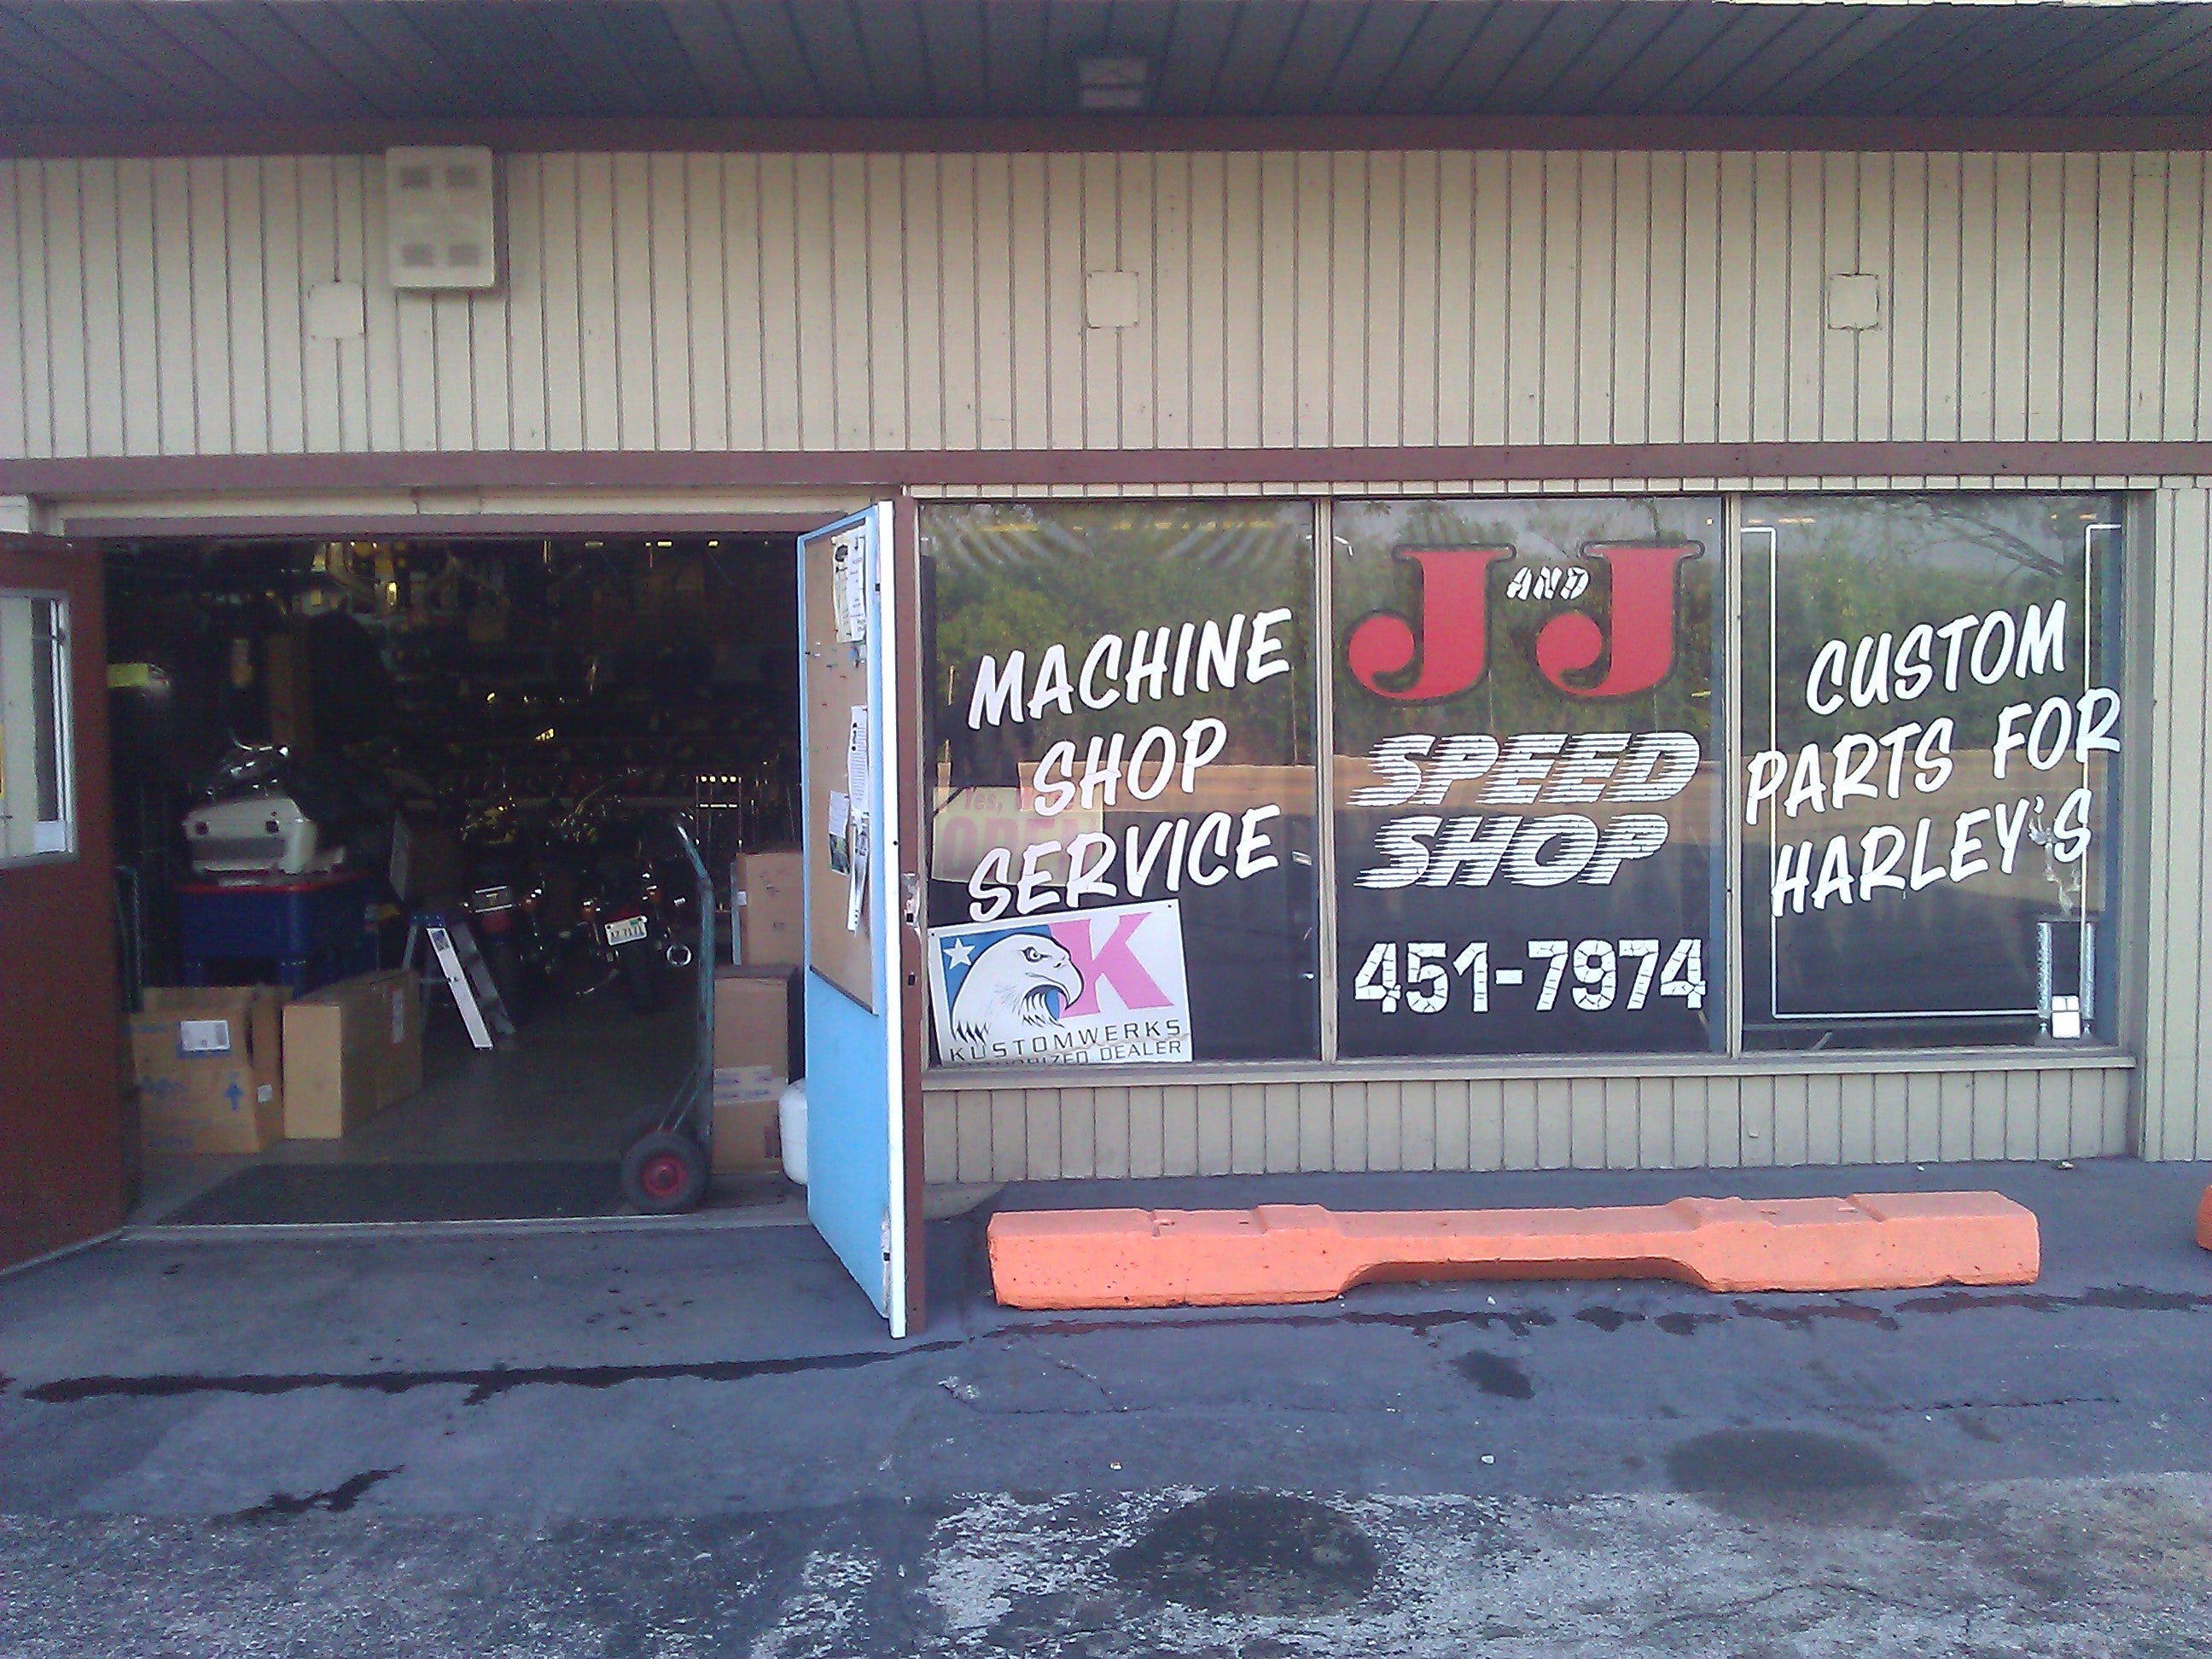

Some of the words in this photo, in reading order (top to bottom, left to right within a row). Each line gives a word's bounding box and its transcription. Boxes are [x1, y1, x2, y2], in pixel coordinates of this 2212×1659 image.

[1347, 542, 1516, 703] J
[1506, 567, 1591, 600] AND
[1536, 539, 1705, 701] J
[967, 607, 1293, 731] MACHINE
[1806, 598, 2067, 716] CUSTOM
[1033, 717, 1228, 817] SHOP
[1346, 731, 1702, 807] SPEED
[1745, 717, 1955, 826] PARTS
[1993, 686, 2122, 780] FOR
[968, 803, 1281, 923] SERVICE
[1353, 813, 1670, 888] SHOP
[1771, 788, 2093, 918] HARLEY'S
[1353, 939, 1708, 1014] 451-7974
[949, 1018, 1181, 1062] KUSTOMWERKS
[1099, 1039, 1182, 1062] DEALER
